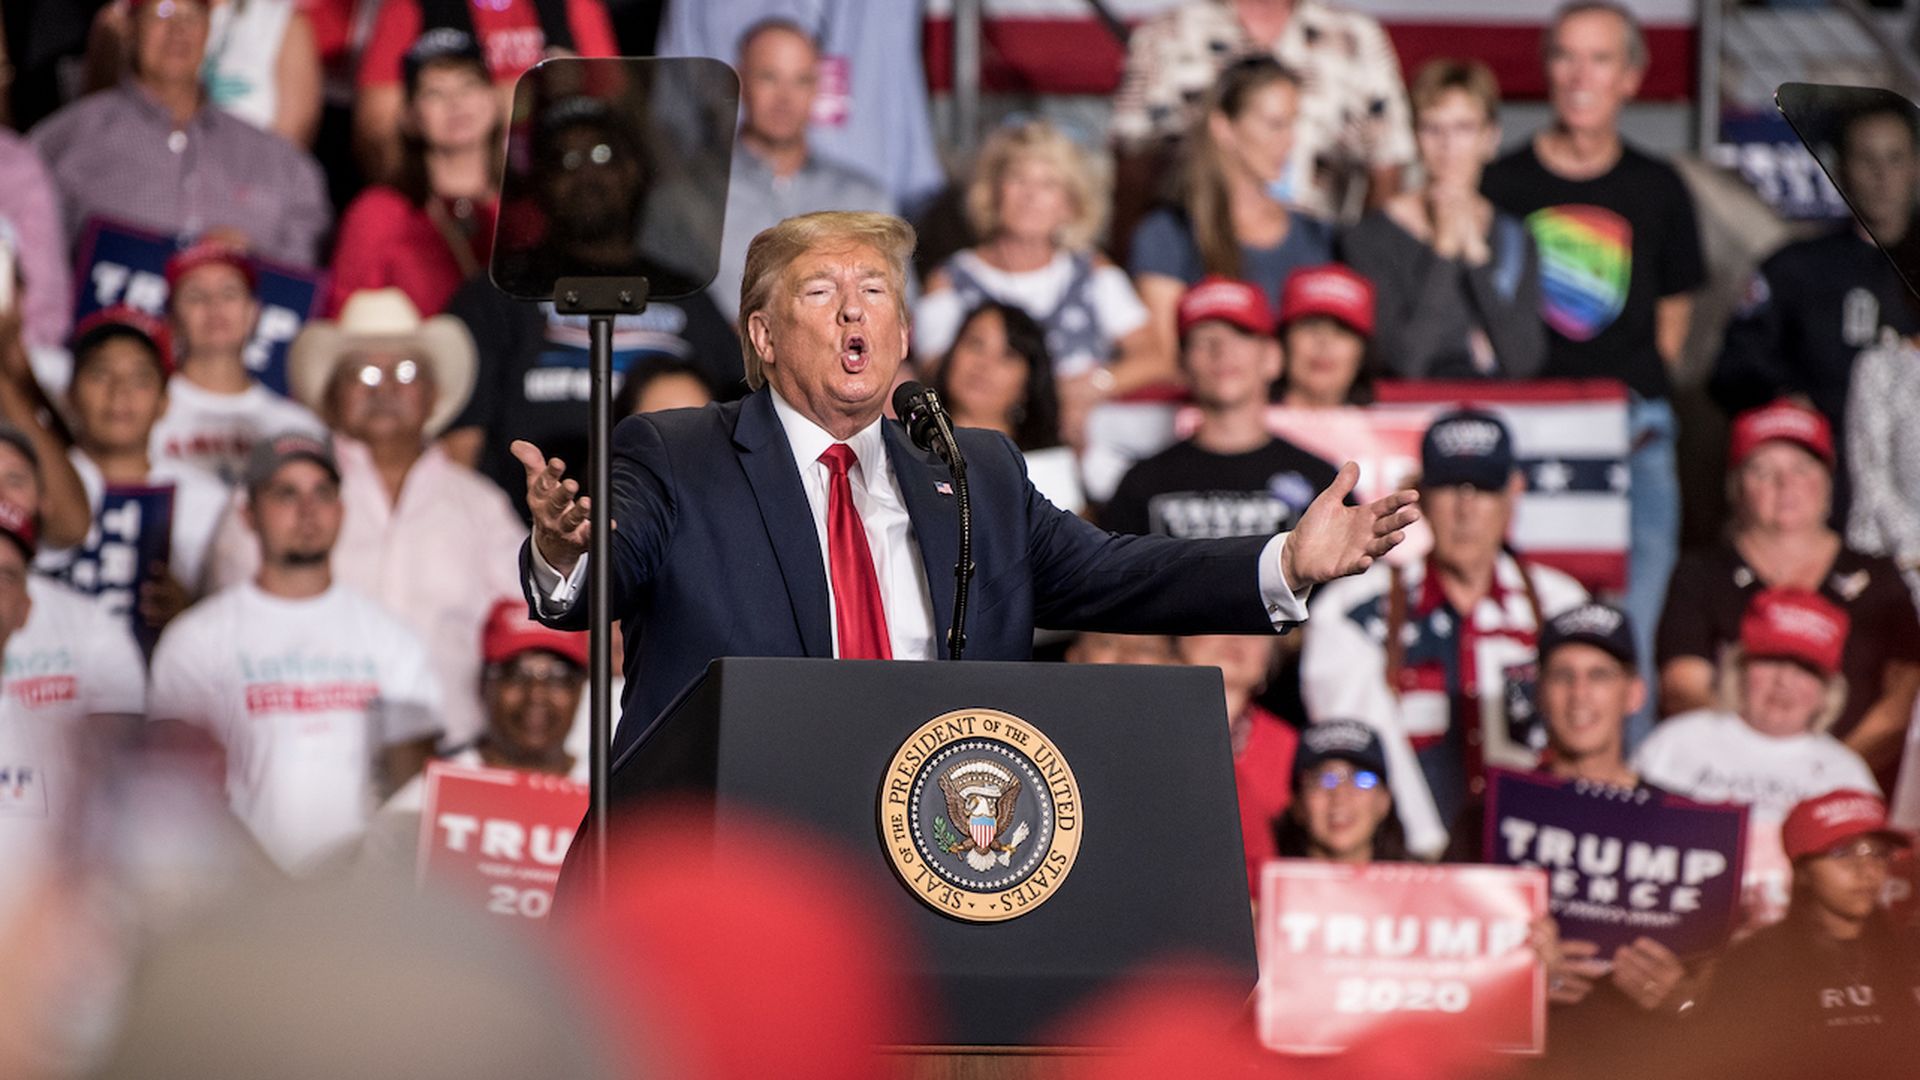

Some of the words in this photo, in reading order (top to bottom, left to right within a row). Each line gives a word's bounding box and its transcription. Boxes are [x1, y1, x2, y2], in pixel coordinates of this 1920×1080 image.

[983, 719, 1001, 733] OF
[1005, 724, 1030, 746] THE
[889, 717, 977, 806] PRESIDENT
[1033, 744, 1075, 831] UNITED
[438, 811, 576, 866] TRU
[891, 813, 906, 843] THE
[1501, 815, 1727, 886] TRUMP
[898, 847, 914, 864] OF
[487, 884, 550, 919] 20
[914, 864, 964, 909] SEAL
[1000, 849, 1067, 912] STATES
[1519, 859, 1702, 912] ENCE
[1280, 912, 1530, 958] TRUMP
[1335, 977, 1471, 1014] 2020
